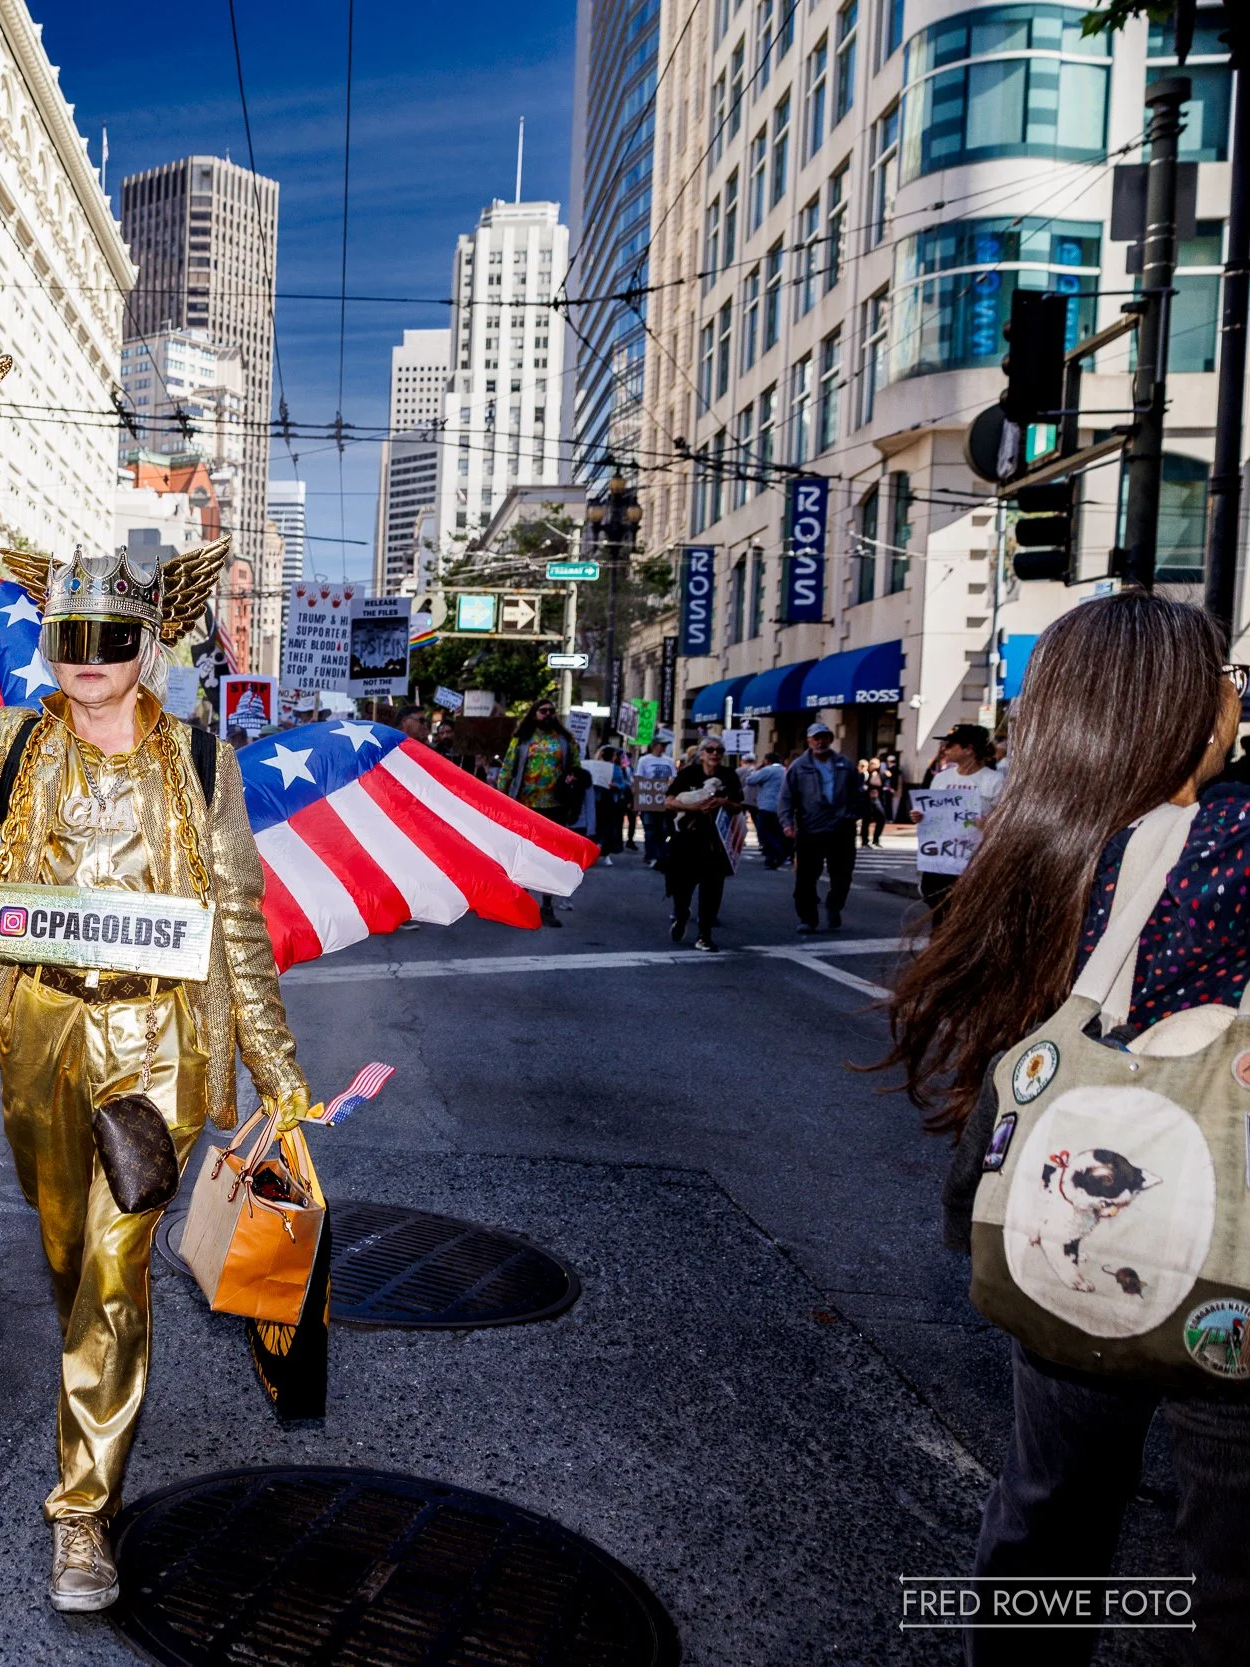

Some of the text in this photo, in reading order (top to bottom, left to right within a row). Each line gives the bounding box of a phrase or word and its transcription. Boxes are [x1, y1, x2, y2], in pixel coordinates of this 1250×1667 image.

[793, 486, 821, 605] ROSS
[688, 552, 710, 644] ROSS
[298, 612, 348, 626] TRUMP & HI
[296, 626, 347, 639] SUPPORTER
[288, 638, 348, 652] HAVE BLOOD O
[353, 636, 407, 657] EPSTEIN
[289, 651, 348, 667] THEIR HANDS
[287, 665, 347, 678] STOP FUNDIN
[231, 683, 268, 693] STOP
[855, 689, 900, 703] ROSS
[639, 781, 651, 791] NO
[638, 794, 652, 805] NO
[915, 795, 963, 812] TRUMP
[30, 909, 188, 949] CPAGOLDSF
